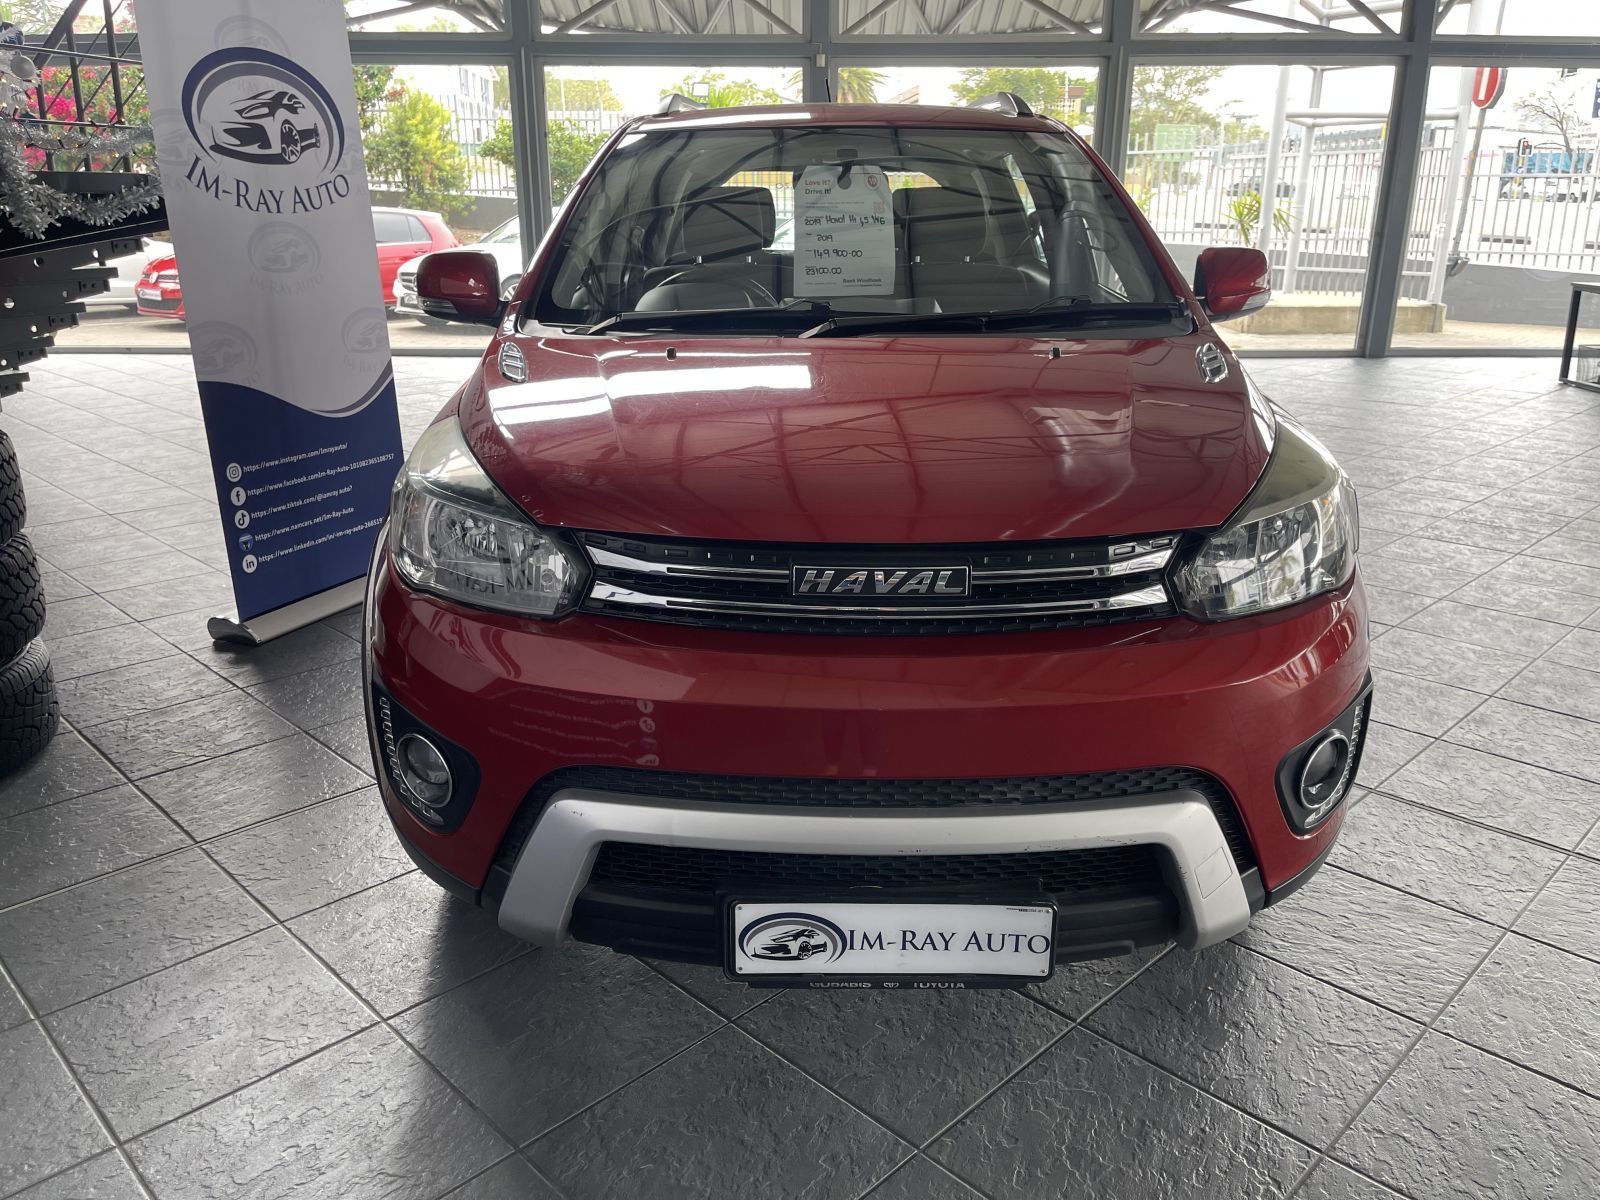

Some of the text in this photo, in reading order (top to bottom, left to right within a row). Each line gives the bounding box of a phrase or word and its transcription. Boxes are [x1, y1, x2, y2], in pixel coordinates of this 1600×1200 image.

[184, 153, 284, 214] IM-RAY
[292, 174, 350, 214] AUTO
[817, 234, 833, 242] 2019
[799, 570, 964, 593] HAVAL
[847, 929, 1050, 954] IM-RAY AUTO
